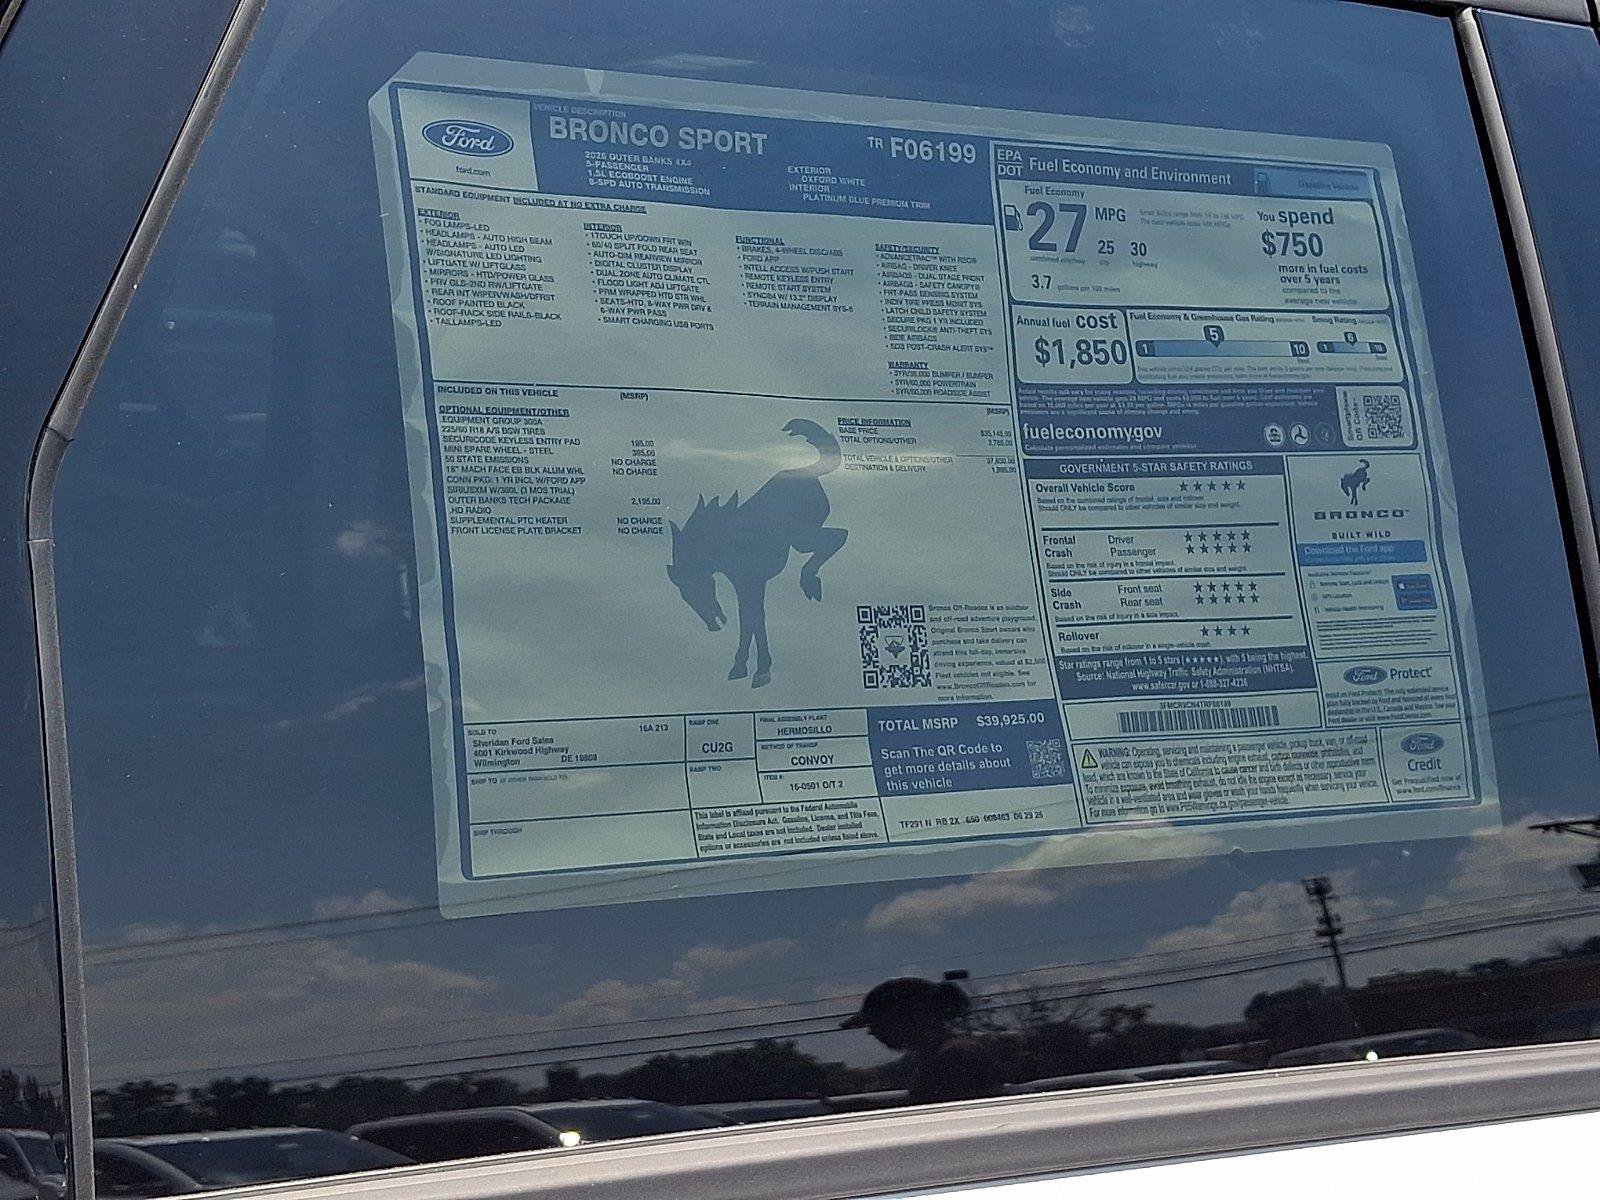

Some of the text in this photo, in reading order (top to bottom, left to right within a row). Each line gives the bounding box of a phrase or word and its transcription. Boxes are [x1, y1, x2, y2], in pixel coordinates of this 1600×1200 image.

[442, 126, 495, 151] Ford
[550, 116, 768, 155] BRONCO SPORT
[867, 136, 976, 164] TR F06199
[997, 150, 1022, 162] EPA
[609, 152, 672, 165] OUTER BANKS
[585, 160, 649, 172] 5-PASSENGER
[788, 166, 832, 174] EXTERIOR
[998, 165, 1023, 176] DOT
[608, 170, 657, 182] ECOBOOST
[660, 175, 693, 184] ENGINE
[1029, 158, 1232, 187] Fuel Economy and Environment
[802, 176, 866, 186] OXFORD WHITE
[619, 180, 710, 196] AUTO TRANSMISSION
[789, 184, 830, 192] INTERIOR
[1025, 186, 1085, 199] Fuel Economy
[414, 186, 460, 198] STANDARD
[462, 191, 510, 203] EQUIPMENT
[514, 196, 556, 206] INCLUDED
[584, 202, 612, 211] EXTRA
[614, 204, 647, 214] CHARGE
[803, 194, 846, 202] PLATINUM
[849, 196, 870, 204] BLUE
[911, 201, 930, 209] TRIM
[1257, 212, 1275, 222] You
[1279, 208, 1334, 227] spend
[1027, 202, 1087, 252] 27
[1095, 208, 1126, 222] MPG
[1098, 241, 1147, 256] 25 30
[1262, 229, 1323, 258] $750
[1278, 264, 1368, 274] more in fuel costs
[1031, 275, 1052, 289] 3.7
[1281, 275, 1341, 286] over 5 years
[1017, 313, 1118, 329] Annual fuel cost
[1148, 314, 1181, 322] Economy
[1251, 315, 1274, 323] Rating
[1210, 328, 1218, 341] 5
[1035, 335, 1127, 369] $1,850
[1294, 344, 1305, 355] 10
[437, 386, 482, 395] INCLUDED
[500, 388, 520, 396] THIS
[521, 389, 558, 397] VEHICLE
[439, 405, 569, 417] OPTIONAL EQUIPMENT/OTHER
[1022, 423, 1162, 443] fueleconomy.gov
[1059, 461, 1252, 473] GOVERNMENT 5-STAR SAFETY RATINGS
[1036, 483, 1135, 493] Overall Vehicle Score
[450, 516, 515, 525] SUPPLEMENTAL
[535, 517, 568, 525] HEATER
[1314, 509, 1405, 520] BRONCO
[617, 517, 663, 525] NO CHARGE
[481, 527, 515, 535] LICENSE
[545, 527, 582, 535] BRACKET
[618, 527, 663, 535] NO CHARGE
[1043, 535, 1134, 546] Frontal Driver
[1045, 547, 1156, 558] Crash Passenger
[1051, 585, 1163, 598] Side Front seat
[1053, 597, 1163, 610] Crash Rear seat
[1059, 631, 1100, 642] Rollover
[1059, 660, 1074, 669] Star
[1076, 659, 1100, 670] ratings
[1125, 657, 1141, 666] from
[1390, 667, 1432, 680] Protect
[655, 724, 668, 732] 213
[878, 712, 1045, 732] TOTAL MSRP $39,925.00
[777, 726, 832, 736] HERMOSILLO
[473, 739, 509, 747] Sheridan
[511, 738, 530, 746] Ford
[702, 742, 733, 753] CU2G
[495, 747, 533, 755] Kirkwood
[535, 746, 569, 754] Highway
[881, 744, 1002, 760] Scan The QR Code to
[473, 759, 520, 768] Wilmington
[791, 755, 834, 766] CONVOY
[1408, 758, 1442, 771] Credit
[884, 758, 1011, 777] get more details about
[823, 781, 837, 789] O/T
[886, 778, 952, 792] this vehicle
